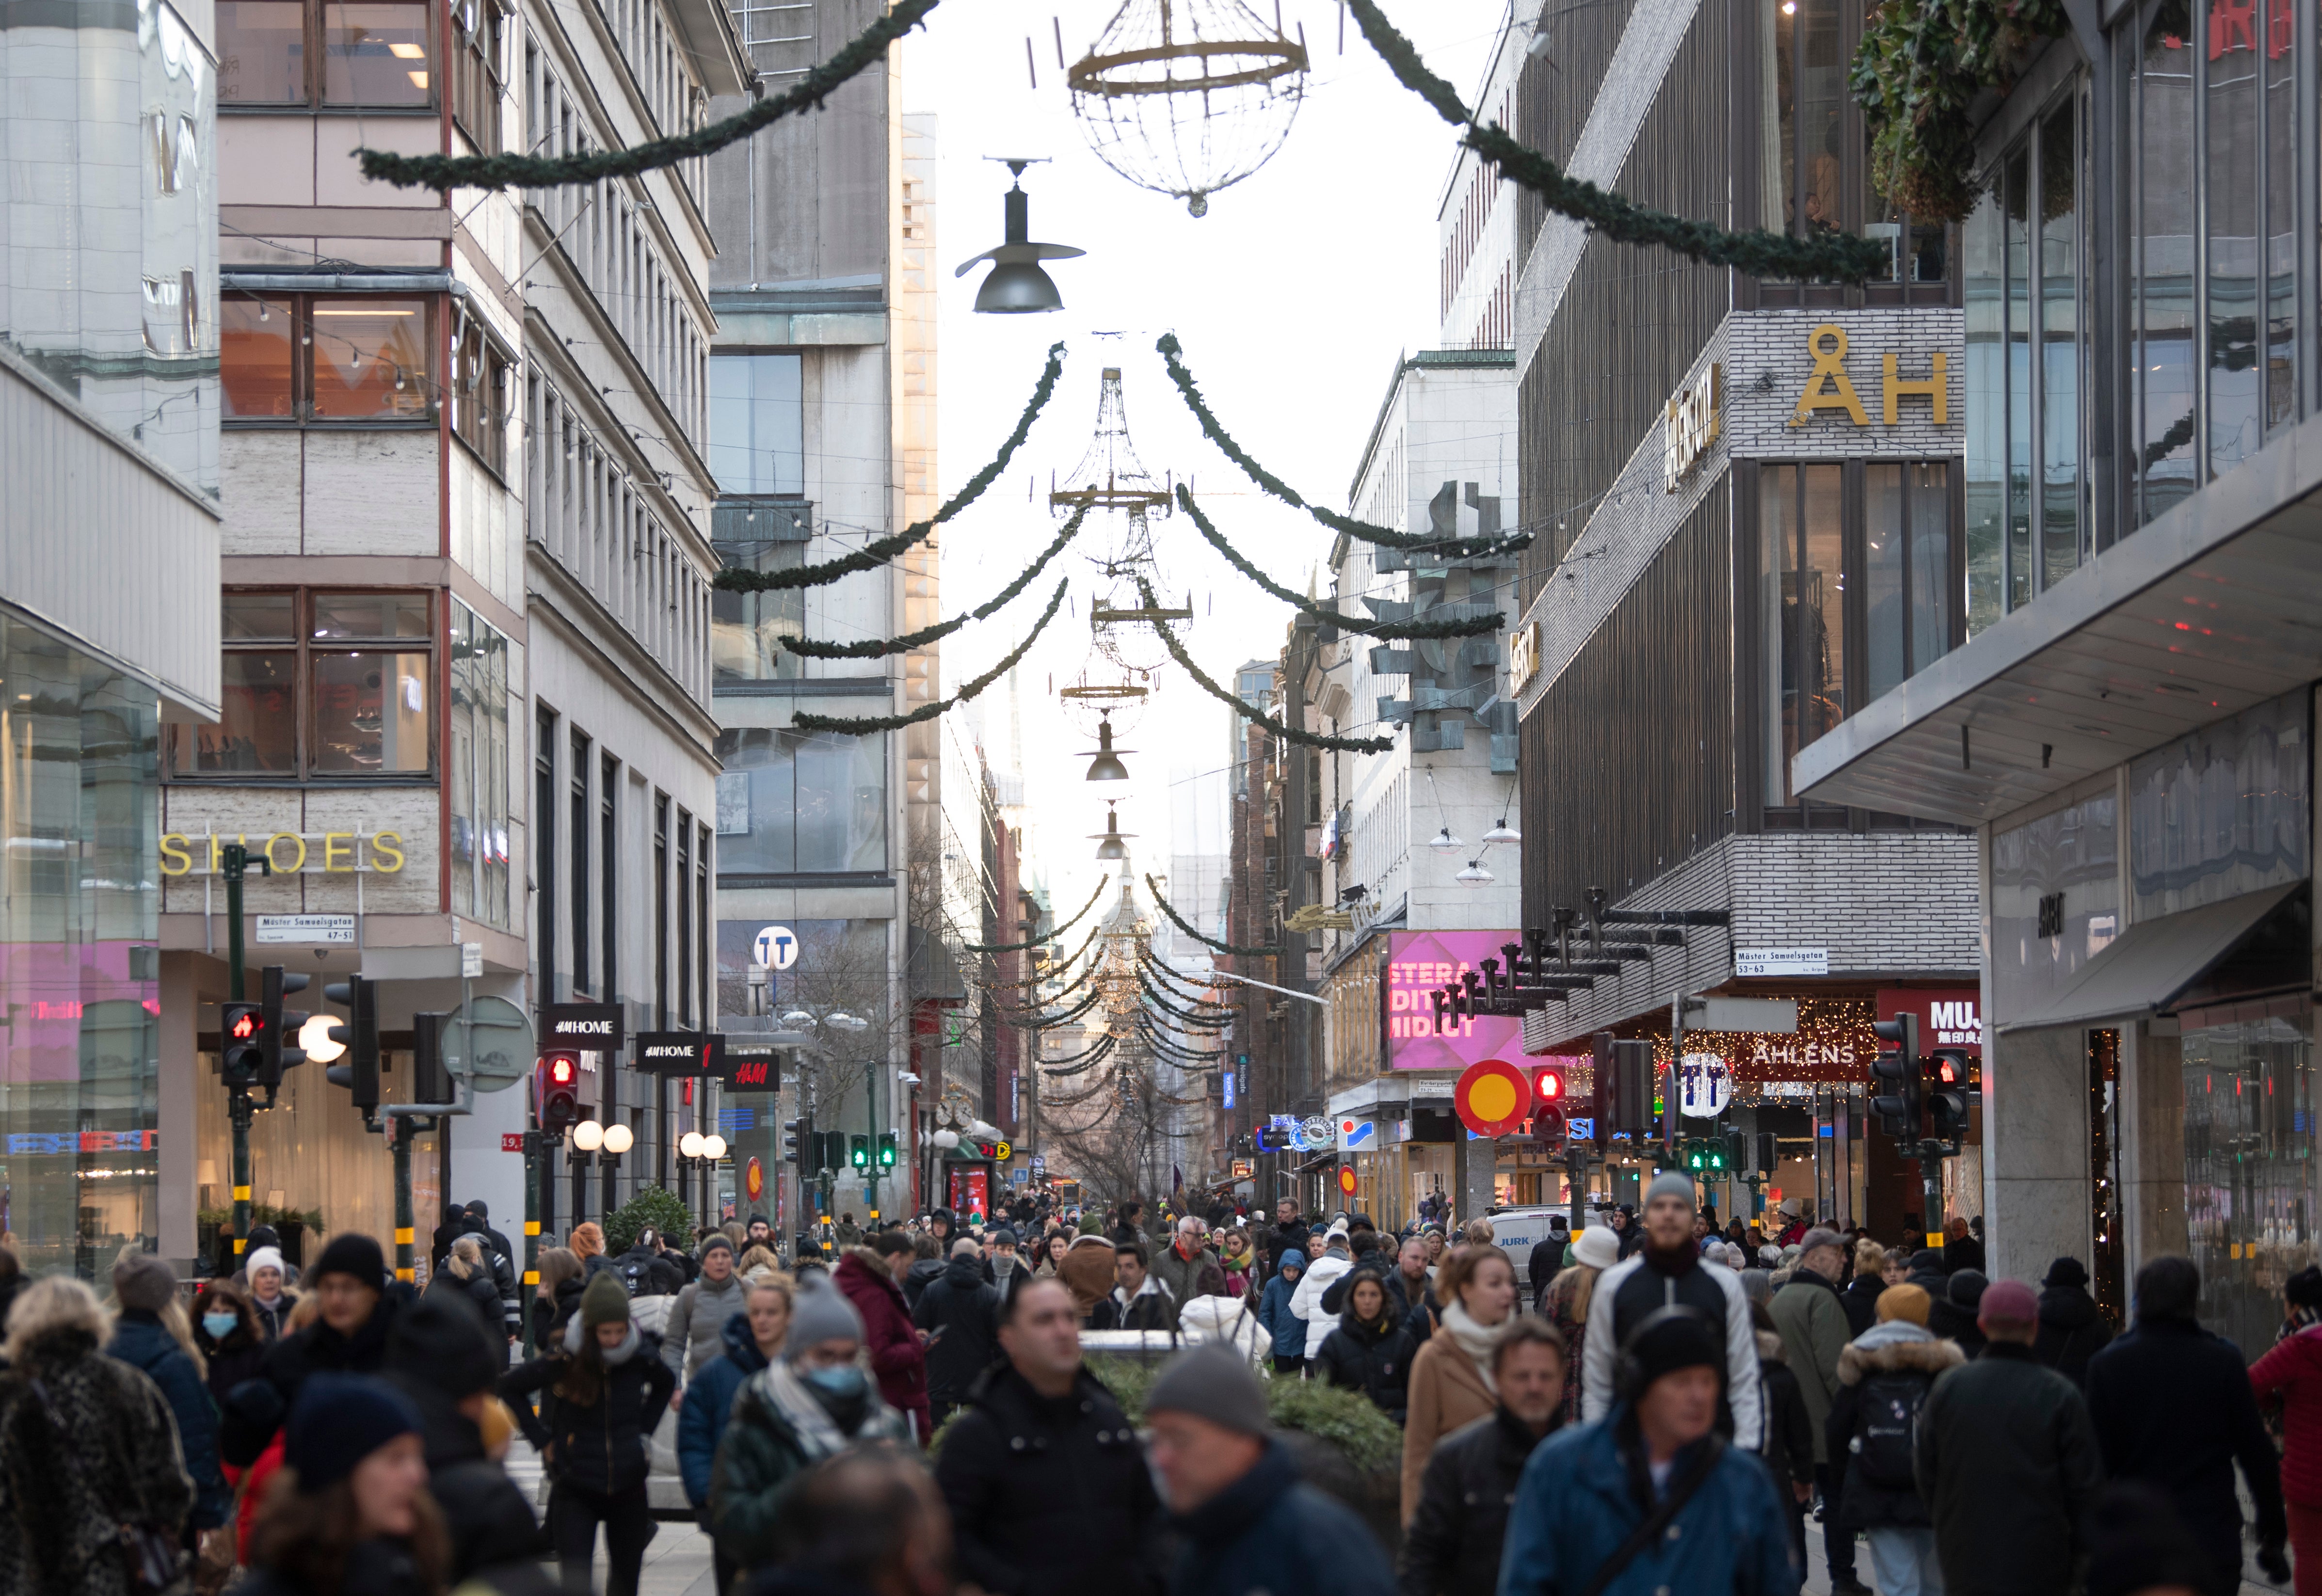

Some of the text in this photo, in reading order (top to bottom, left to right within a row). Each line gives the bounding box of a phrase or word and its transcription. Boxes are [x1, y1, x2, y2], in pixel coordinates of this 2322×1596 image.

[1771, 951, 1823, 961] Samuelsgatan
[573, 1021, 613, 1034] HOME
[659, 1045, 694, 1056] HOME
[1751, 1038, 1855, 1064] ÅHLÉNS
[736, 1062, 768, 1085] H&M
[1302, 1117, 1331, 1131] ESPRESSO
[1499, 1237, 1529, 1246] JURK
